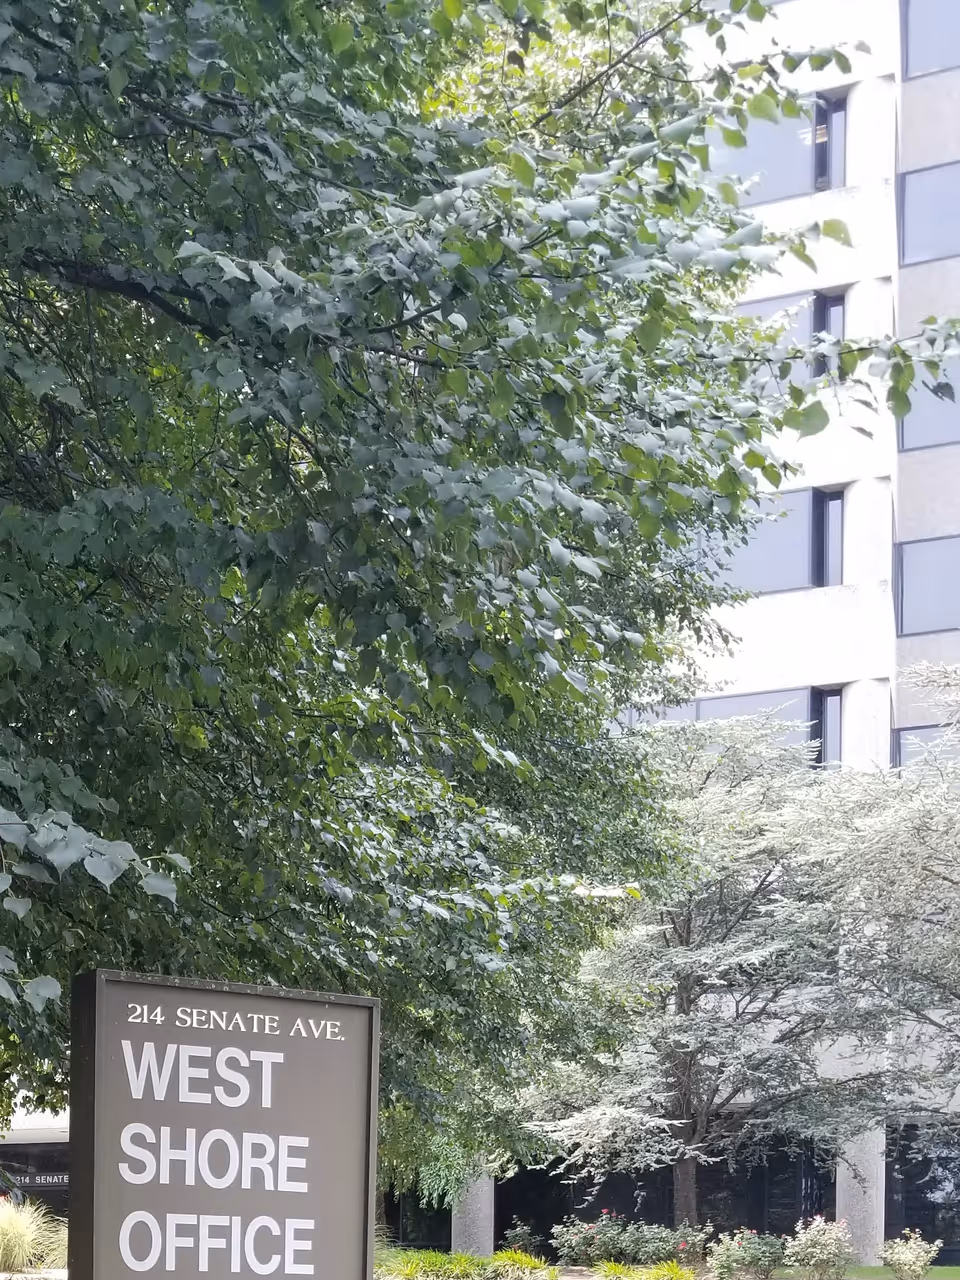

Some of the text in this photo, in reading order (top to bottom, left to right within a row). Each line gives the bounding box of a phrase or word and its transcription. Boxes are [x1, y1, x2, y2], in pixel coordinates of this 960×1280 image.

[127, 1004, 345, 1041] 214 SENATE AVE.
[121, 1040, 284, 1108] WEST
[16, 1175, 69, 1184] 214 SENATE
[118, 1123, 309, 1193] SHORE
[119, 1211, 315, 1275] OFFICE
